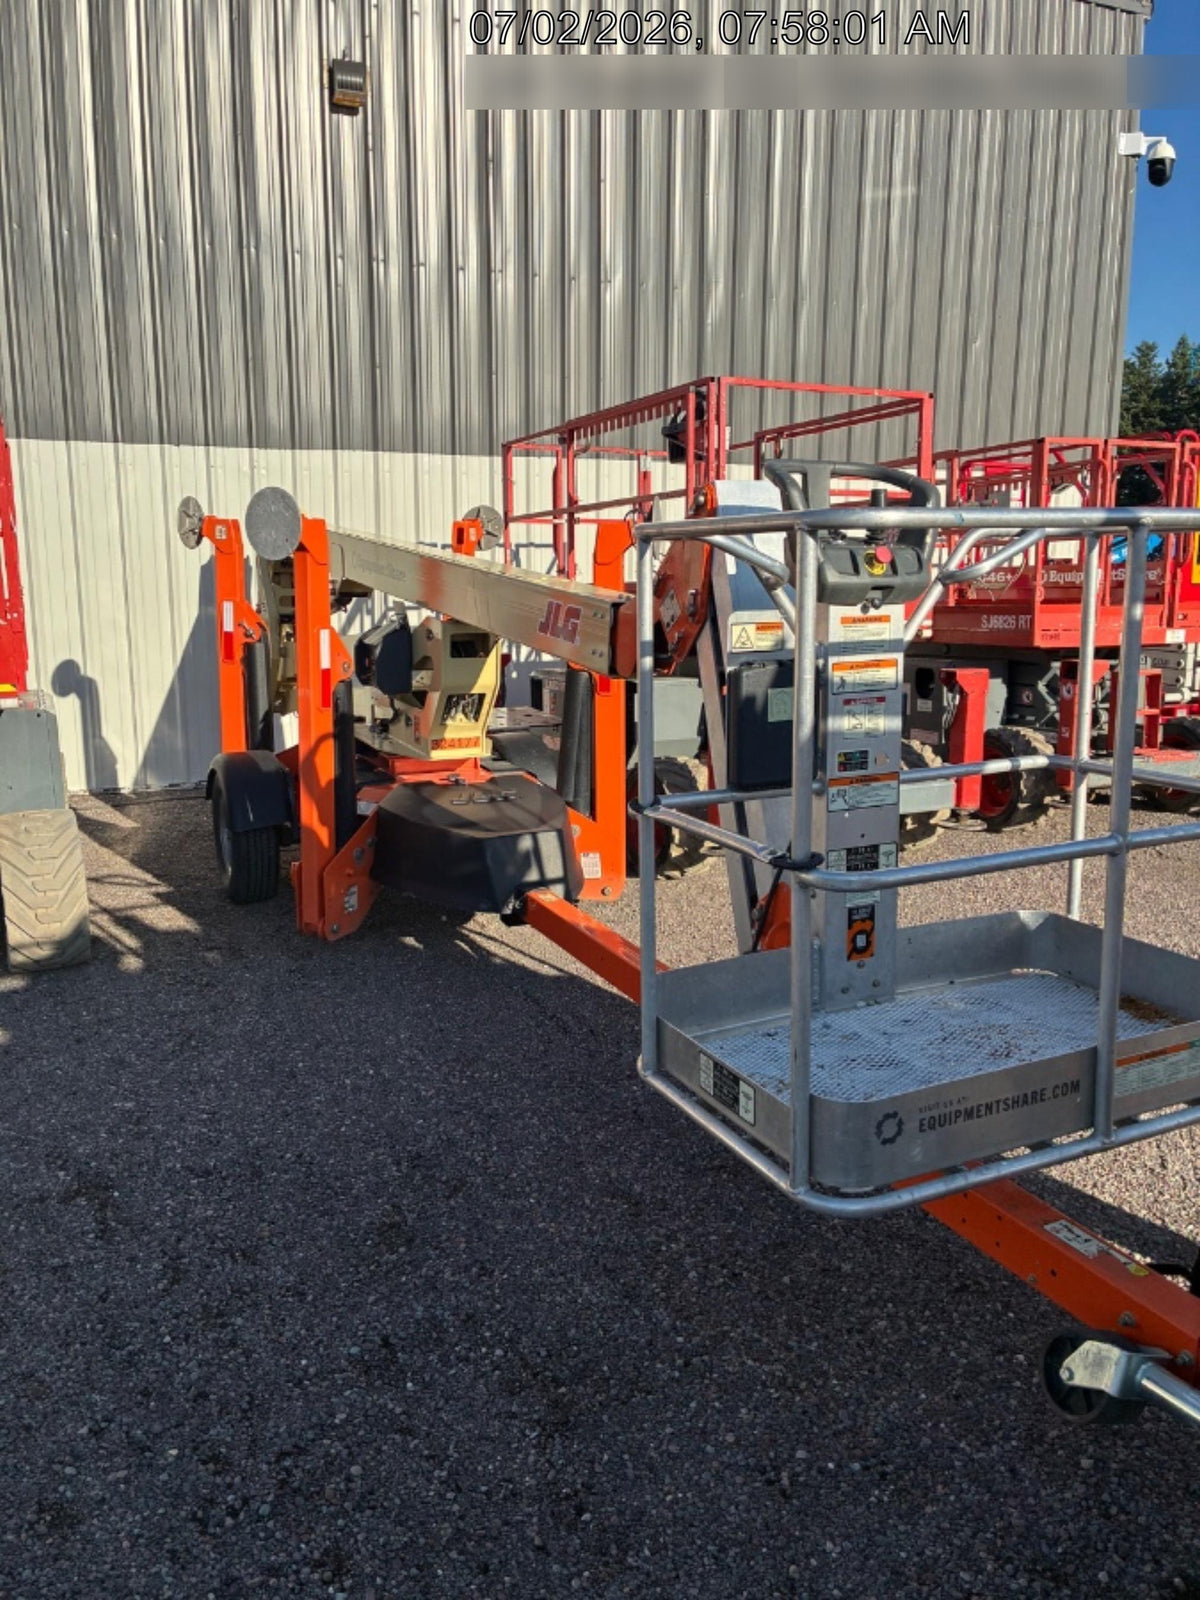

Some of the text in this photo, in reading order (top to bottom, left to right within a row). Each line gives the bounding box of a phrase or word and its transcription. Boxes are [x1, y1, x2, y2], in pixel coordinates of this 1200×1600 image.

[537, 599, 583, 645] JLG
[1018, 614, 1032, 630] RT
[918, 1079, 1081, 1133] EQUIPMENTSHARE.COM
